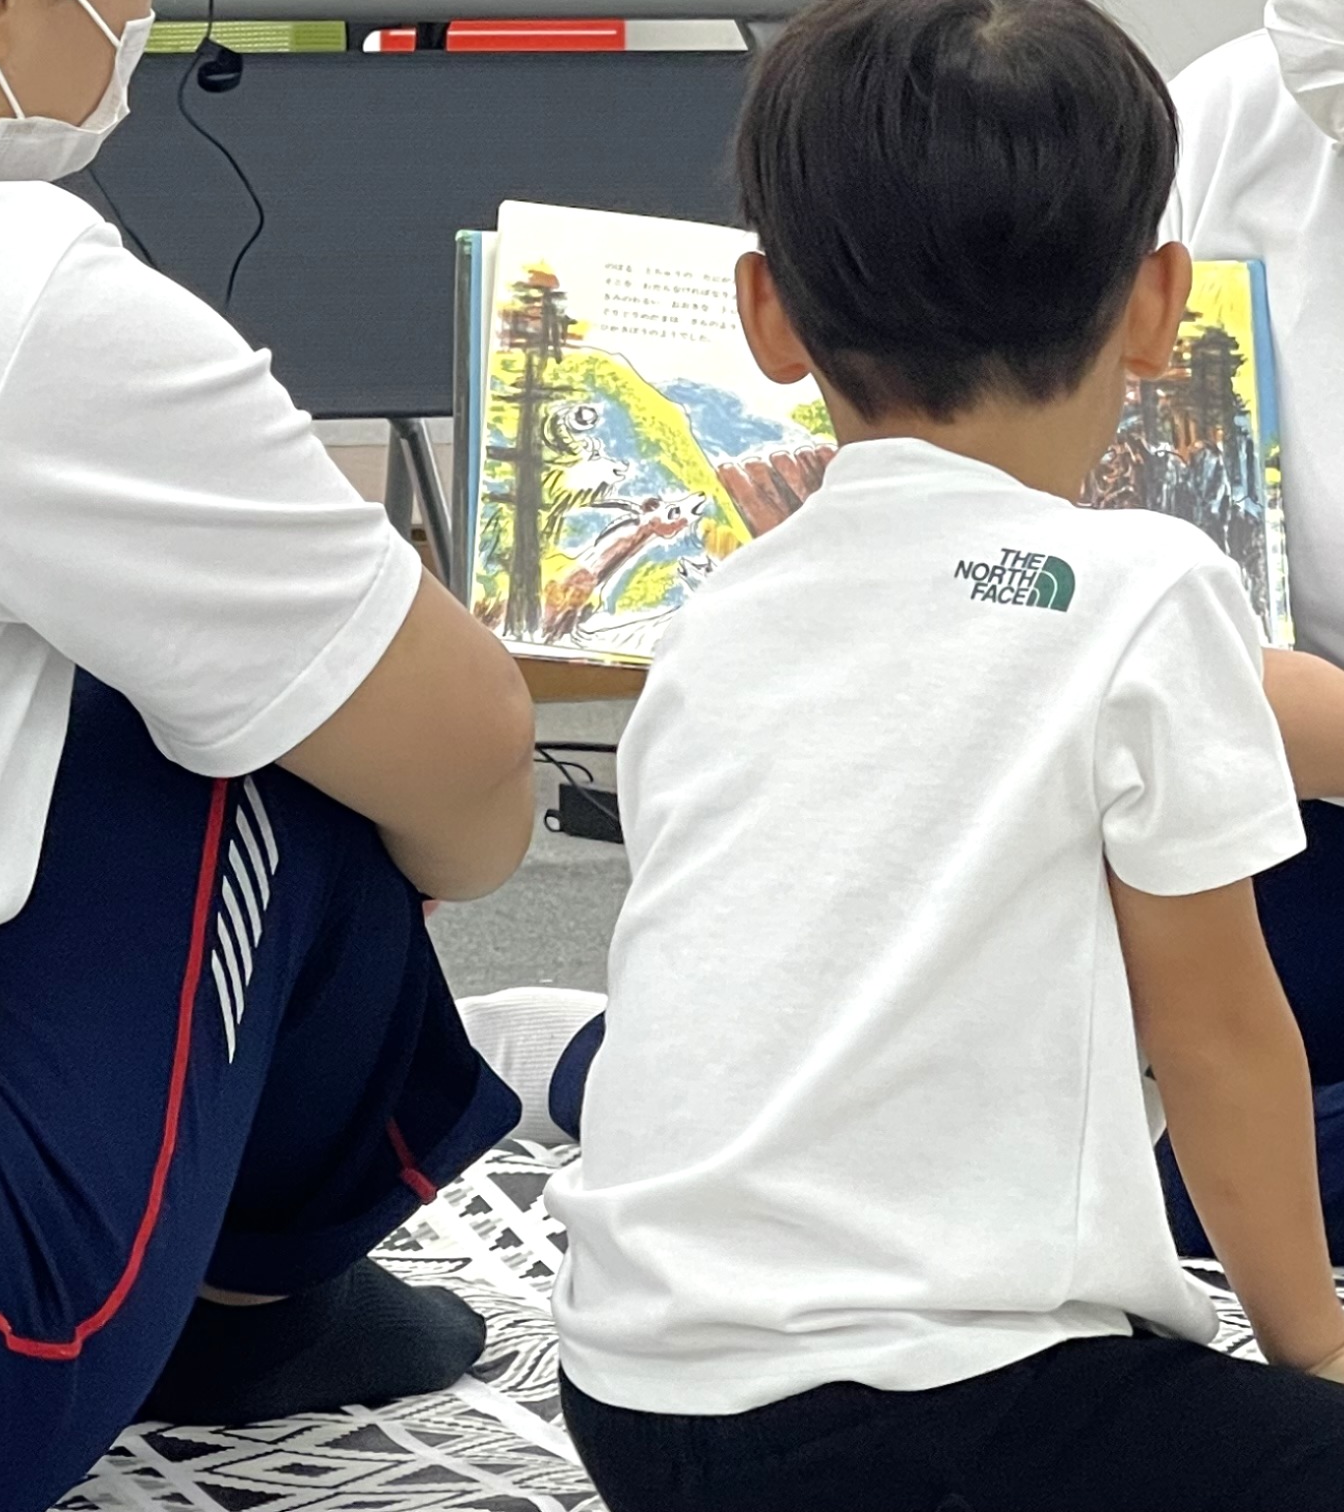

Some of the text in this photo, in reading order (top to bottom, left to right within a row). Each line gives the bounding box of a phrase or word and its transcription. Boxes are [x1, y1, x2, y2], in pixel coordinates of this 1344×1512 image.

[1001, 547, 1045, 569] THE
[954, 559, 1037, 588] NORTH
[970, 582, 1028, 604] FACE
